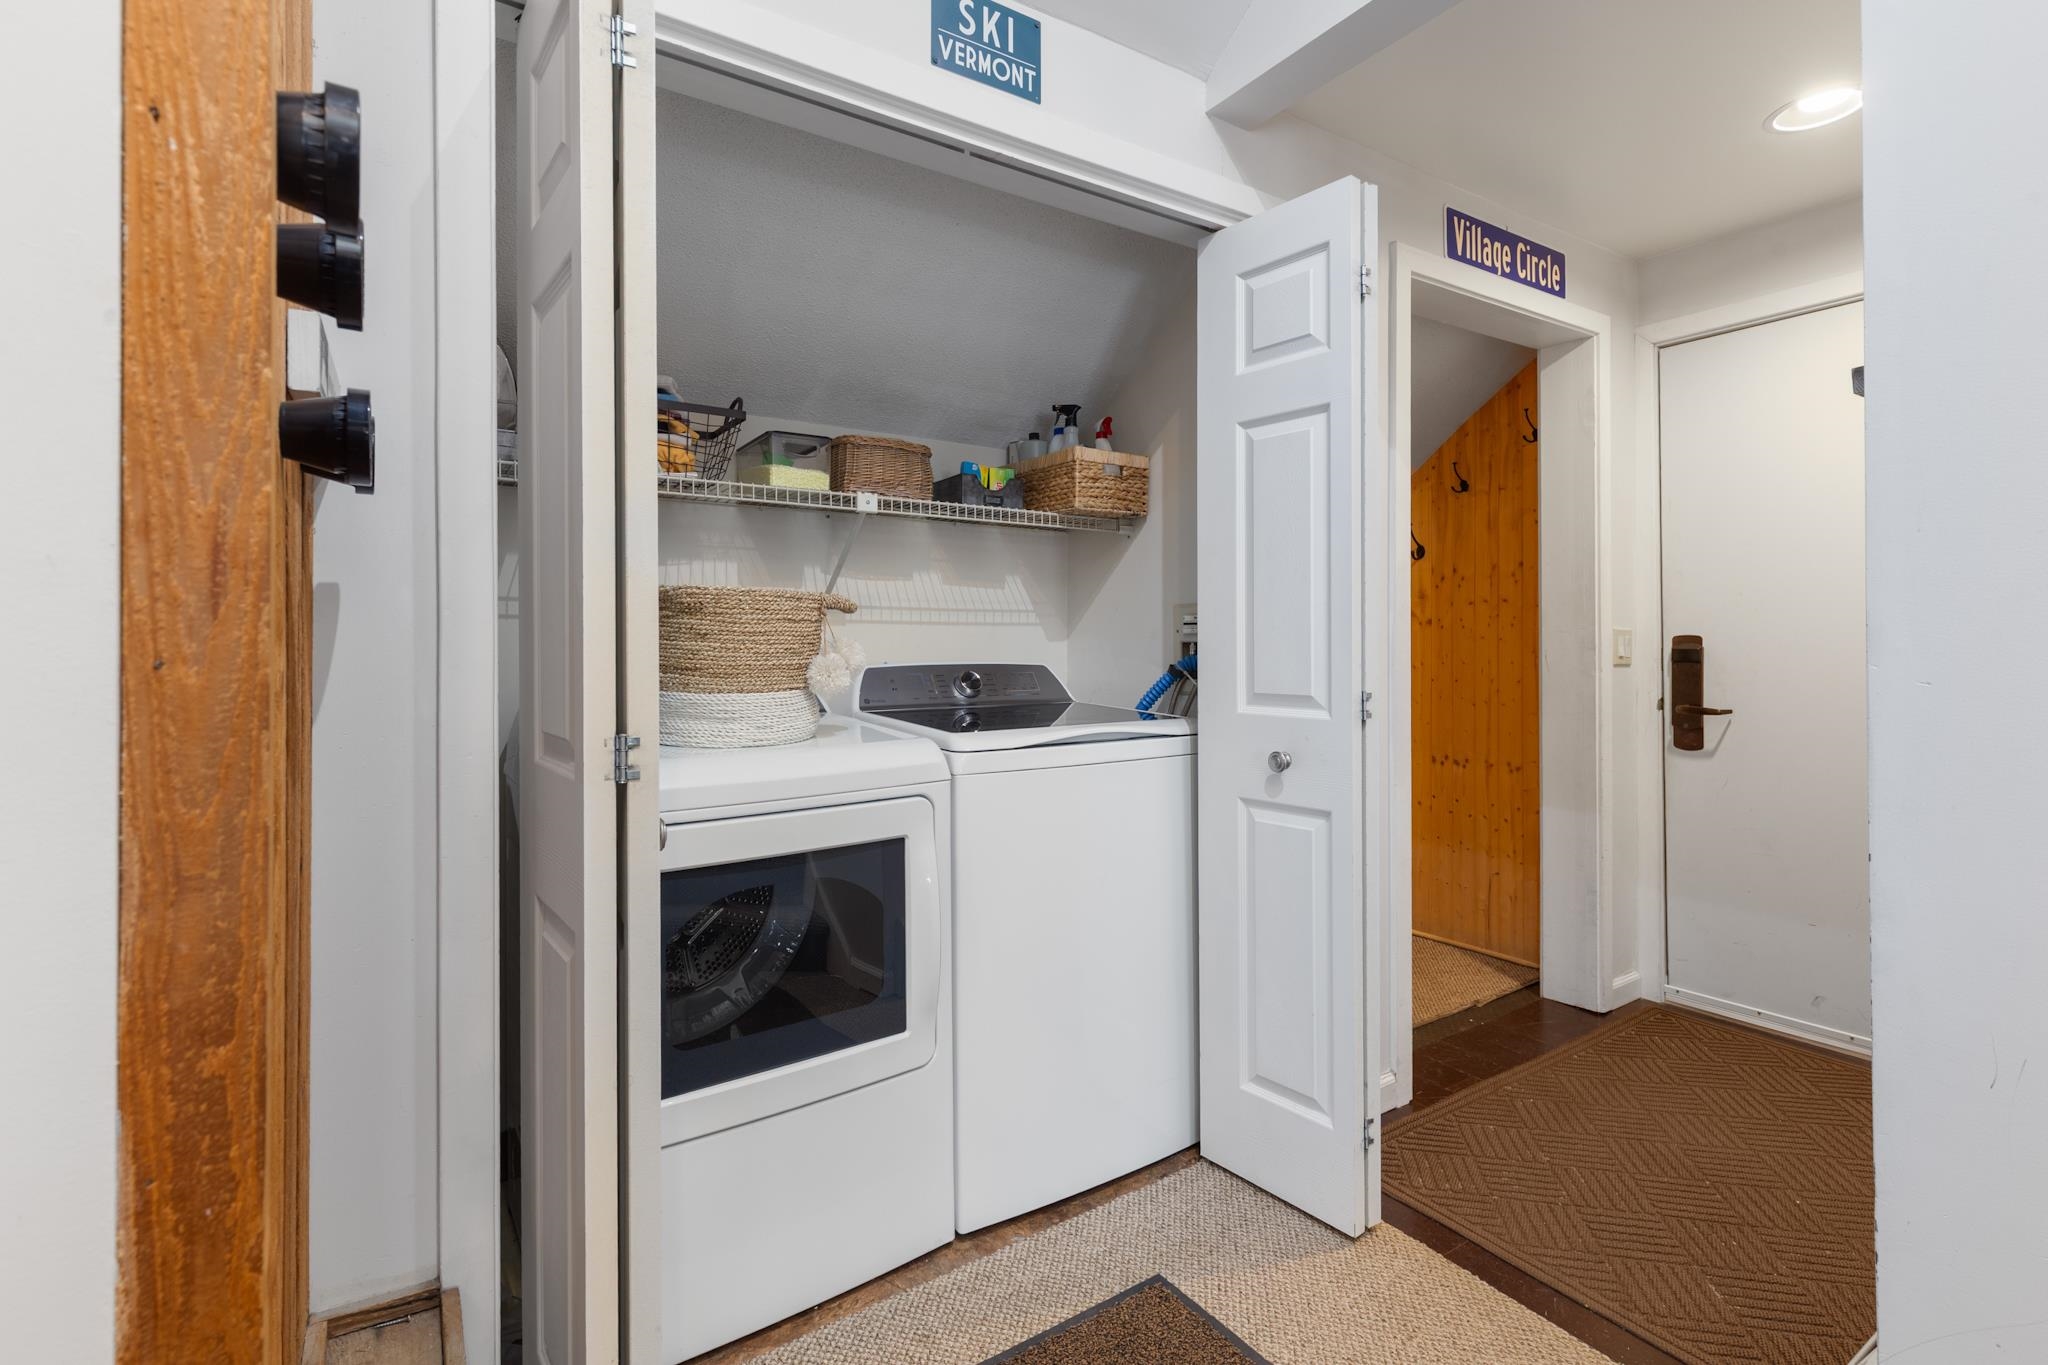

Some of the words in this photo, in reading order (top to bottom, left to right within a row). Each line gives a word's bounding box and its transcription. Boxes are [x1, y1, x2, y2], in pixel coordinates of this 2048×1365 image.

[958, 0, 1014, 54] SKI
[938, 34, 1037, 92] VERMONT
[1453, 215, 1512, 276] Village
[1516, 242, 1561, 292] Circle
